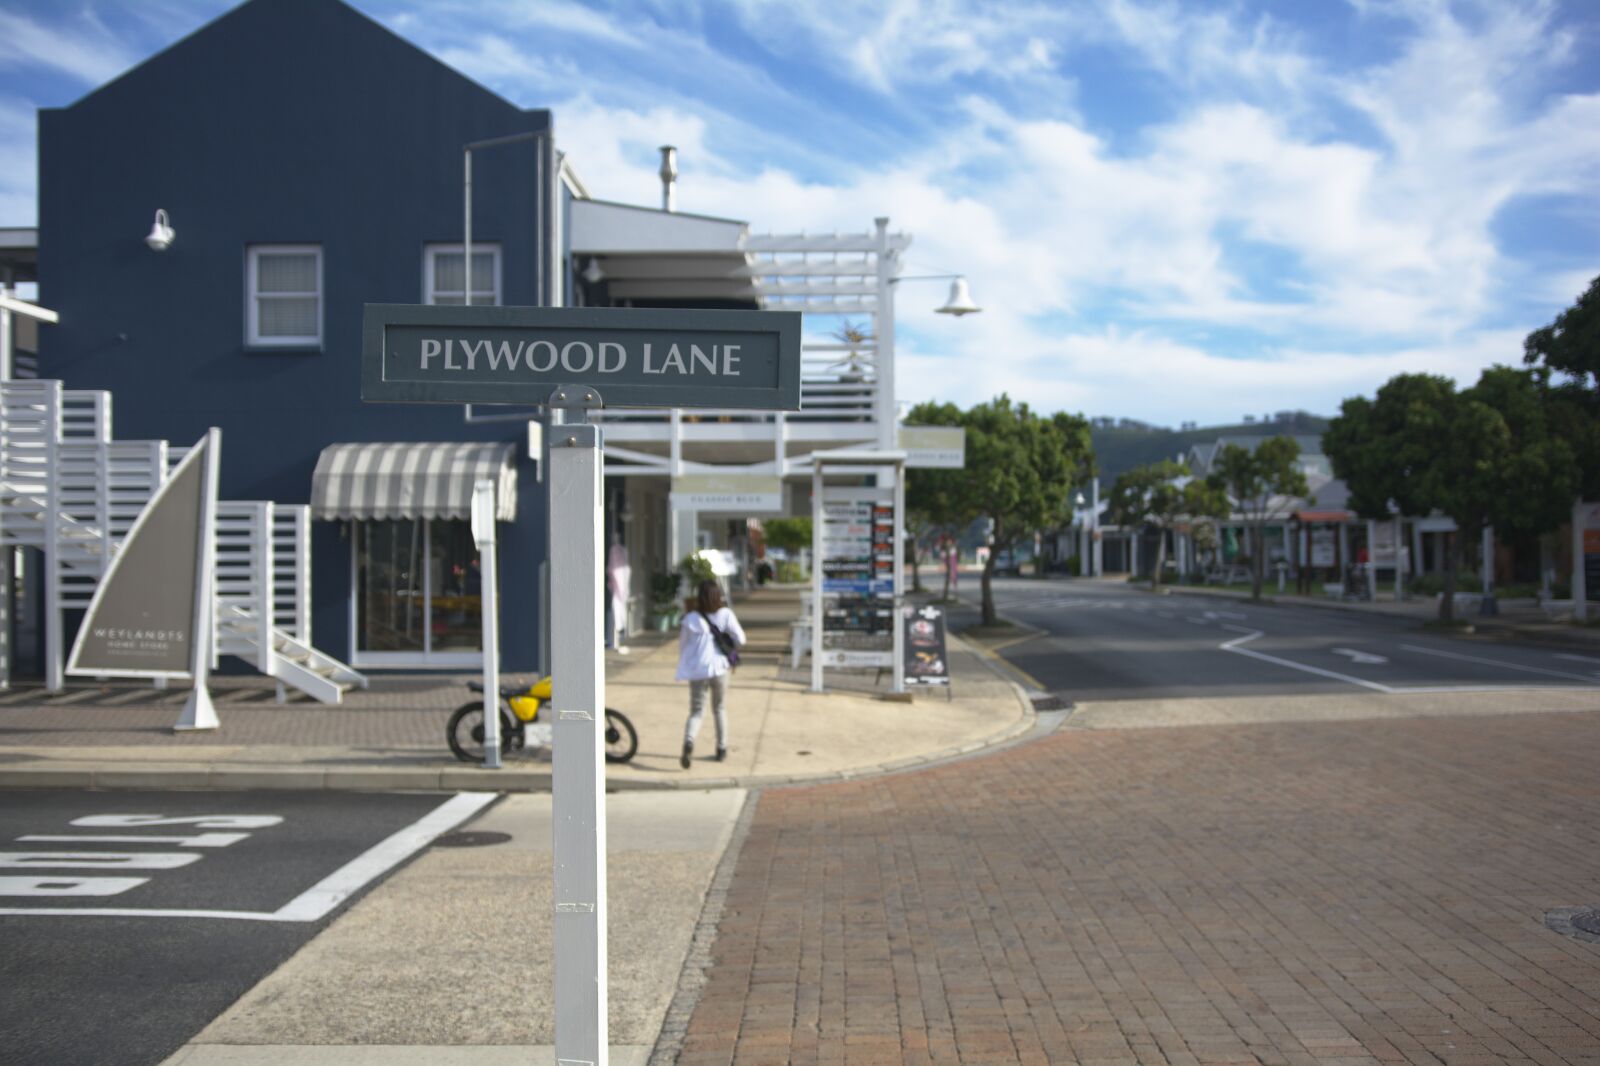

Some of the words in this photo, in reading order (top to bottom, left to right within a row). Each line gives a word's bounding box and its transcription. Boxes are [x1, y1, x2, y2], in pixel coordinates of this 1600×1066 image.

[419, 339, 627, 373] PLYWOOD
[642, 343, 741, 376] LANE
[94, 628, 184, 641] WEYLANDTS
